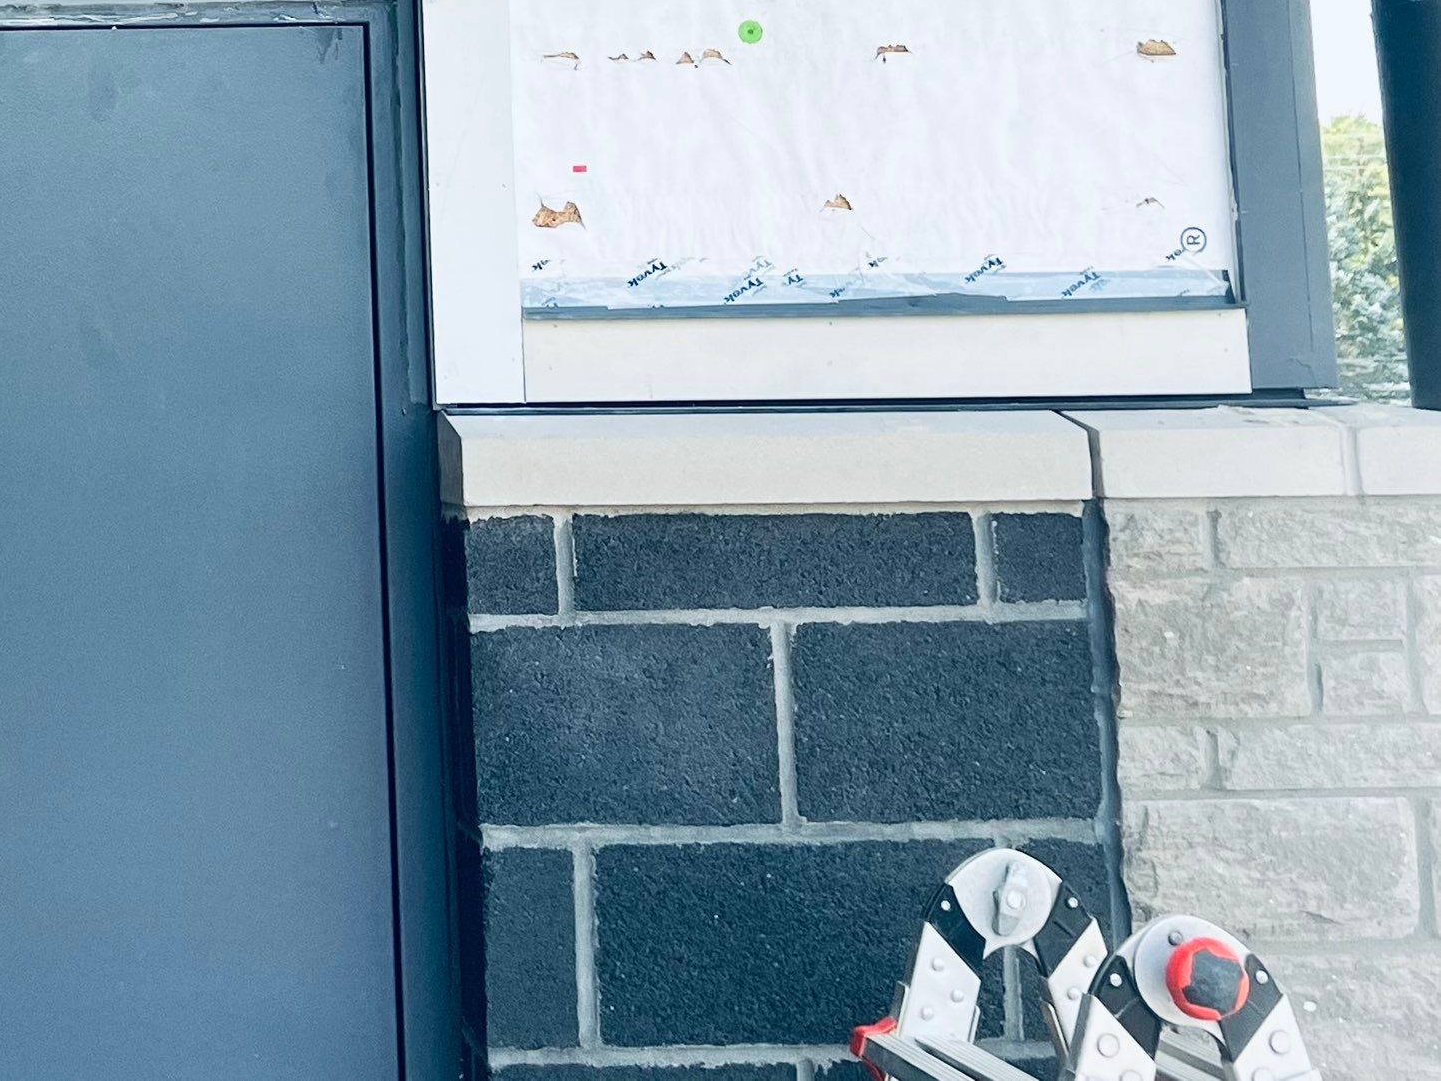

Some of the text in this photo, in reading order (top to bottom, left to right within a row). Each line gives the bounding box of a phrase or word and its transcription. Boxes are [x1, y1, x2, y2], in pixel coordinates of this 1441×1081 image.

[626, 261, 668, 288] Tyvek
[1060, 271, 1102, 298] Tyvek
[723, 277, 765, 304] Tyvek
